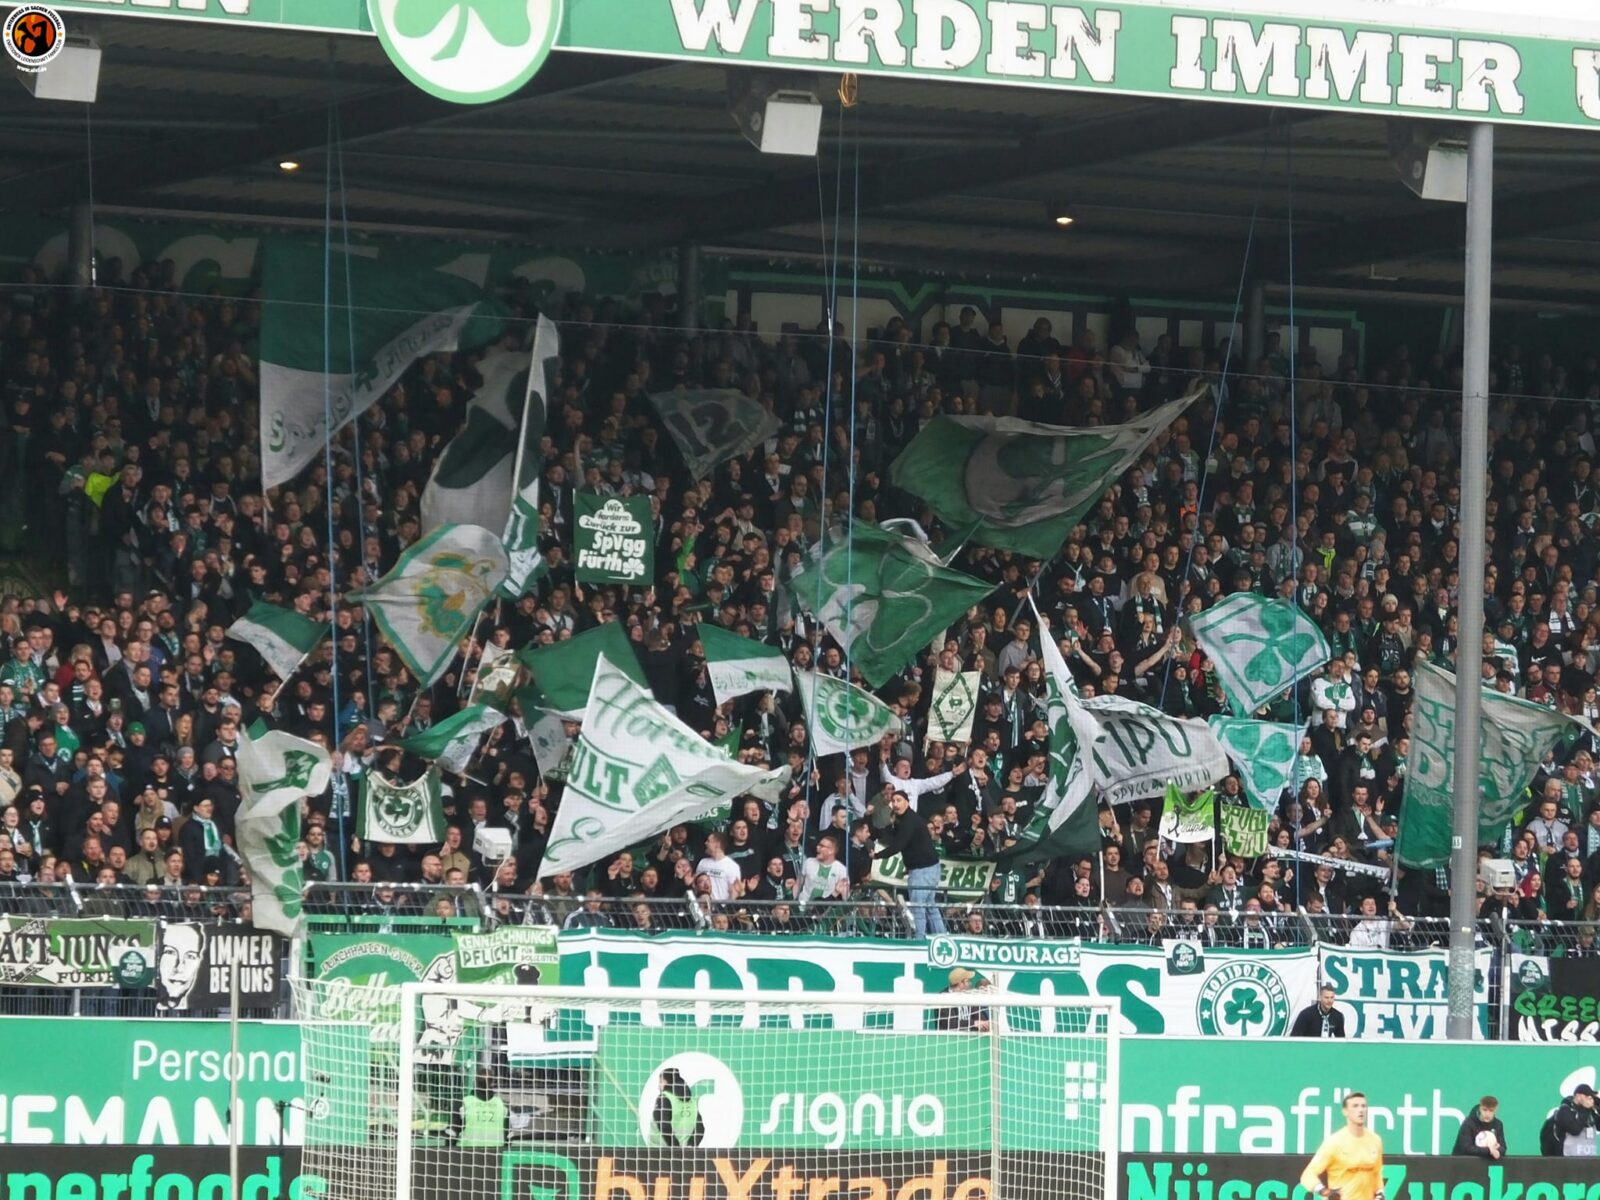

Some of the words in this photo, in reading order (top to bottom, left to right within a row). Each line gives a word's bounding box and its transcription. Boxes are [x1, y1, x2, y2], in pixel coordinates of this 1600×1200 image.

[672, 0, 1122, 82] WERDEN
[1170, 15, 1525, 115] IMMER
[577, 549, 622, 572] Fürth
[592, 531, 646, 558] SpVgg
[209, 934, 274, 966] IMMER
[462, 946, 518, 967] PFLICHT
[960, 942, 1081, 966] ENTOURAGE
[209, 967, 239, 994] BE
[240, 967, 274, 994] UNS
[1202, 963, 1262, 1001] HORIDOS
[1262, 972, 1284, 1003] 1000
[1514, 991, 1600, 1023] GREE
[132, 1040, 306, 1082] Personal
[760, 1091, 945, 1150] signia
